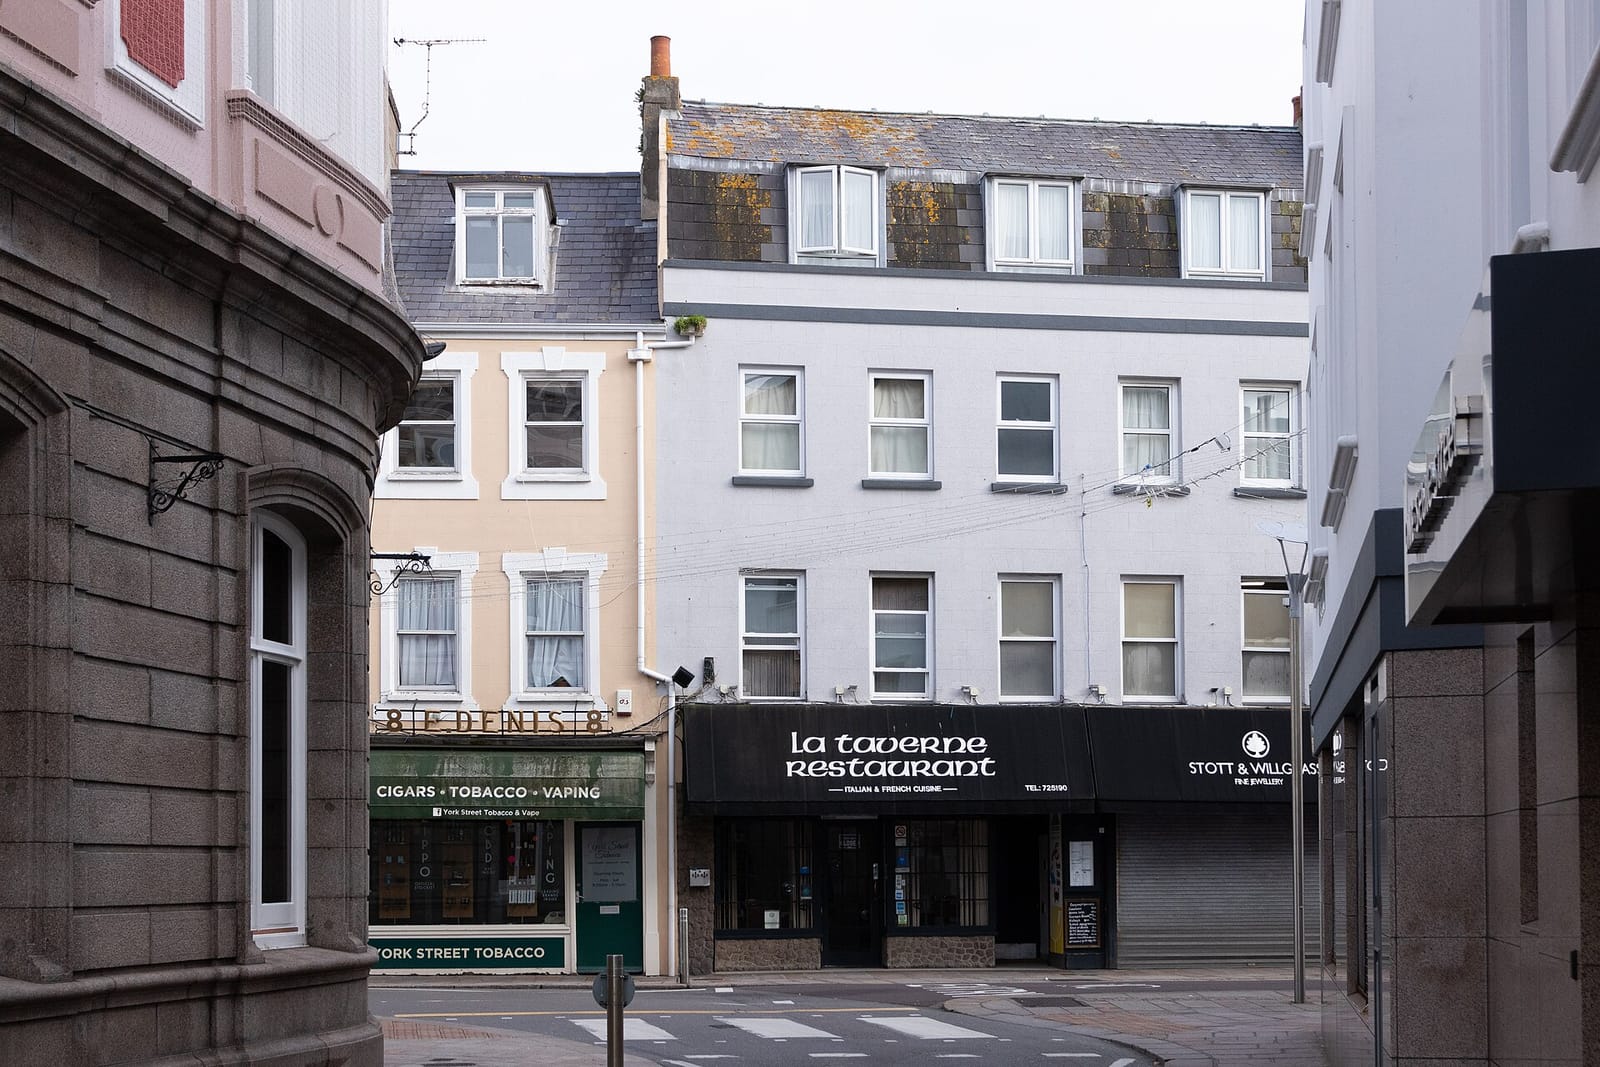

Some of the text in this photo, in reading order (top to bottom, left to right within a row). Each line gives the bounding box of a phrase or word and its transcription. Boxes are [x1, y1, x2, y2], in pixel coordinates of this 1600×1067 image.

[386, 708, 402, 732] 8
[586, 709, 602, 733] 8
[1189, 762, 1233, 775] STOTT
[1238, 763, 1249, 775] &
[1250, 763, 1319, 775] WILLGAS
[1250, 778, 1284, 786] JEWELLERY
[376, 786, 601, 799] CIGARS TOBACCO VAPING
[443, 808, 459, 816] York
[461, 808, 482, 816] Street
[483, 809, 514, 817] Tobacco
[514, 809, 520, 817] &
[521, 809, 540, 818] Vape
[416, 947, 469, 959] STREET
[474, 947, 545, 959] TOBACCO
